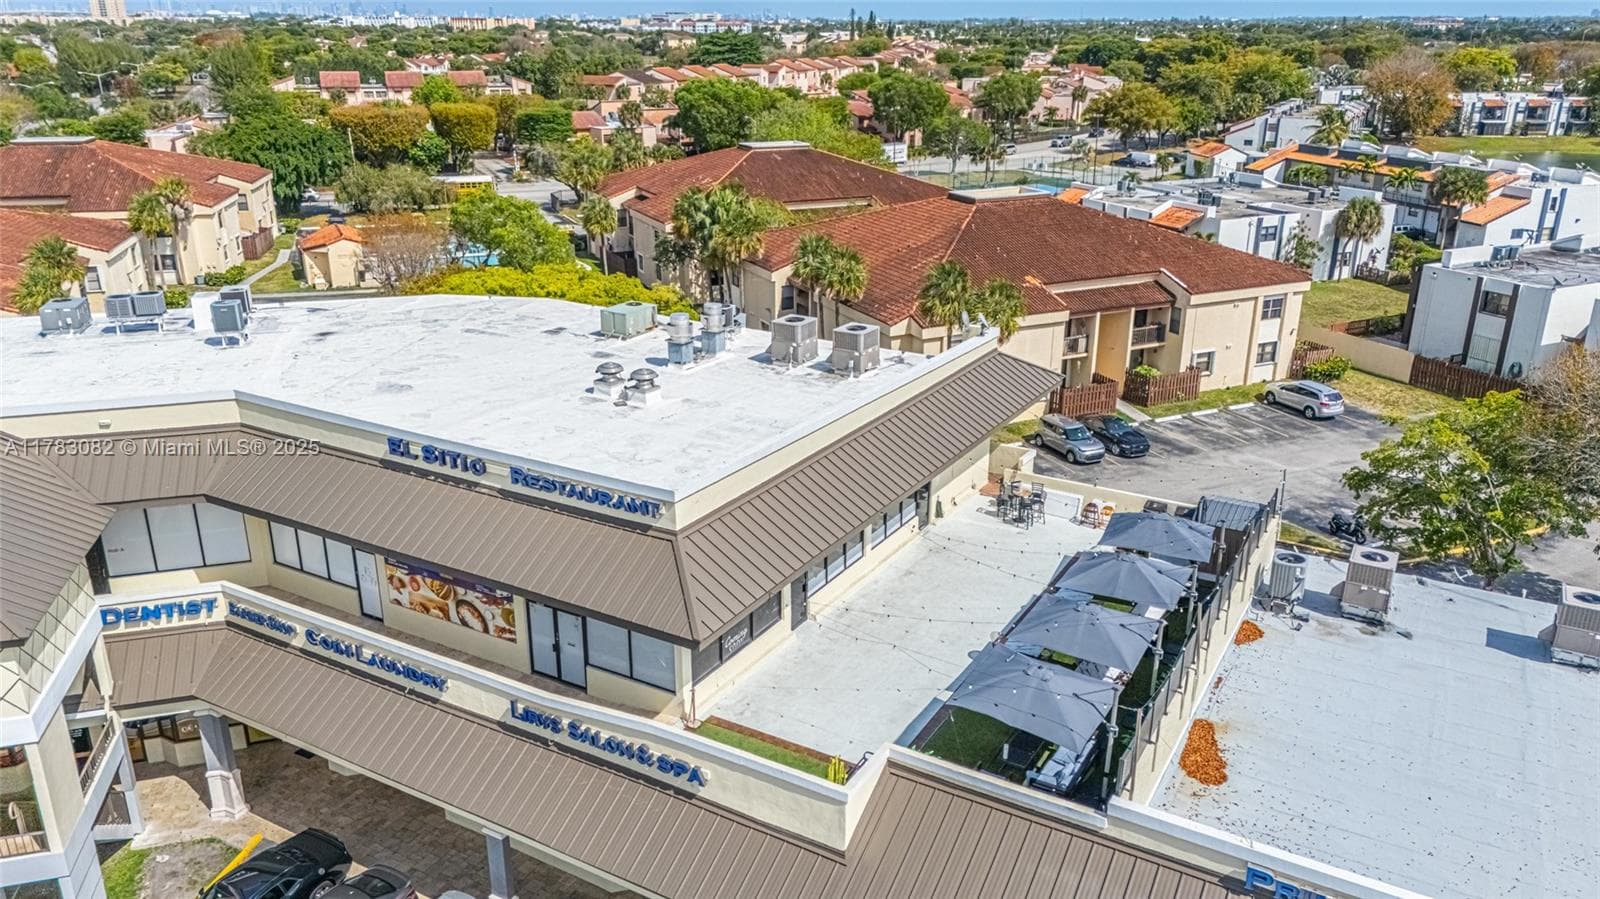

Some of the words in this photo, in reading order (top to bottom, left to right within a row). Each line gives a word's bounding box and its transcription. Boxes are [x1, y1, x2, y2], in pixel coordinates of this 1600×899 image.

[387, 436, 418, 461] EL
[421, 444, 487, 477] SITIO
[509, 465, 664, 519] RESTAURANT
[100, 598, 218, 626] DENTIST
[304, 628, 355, 659] COIN
[355, 644, 448, 693] LAUNDRY
[567, 719, 635, 761] SALON
[635, 743, 655, 768] &
[656, 752, 705, 788] SPA
